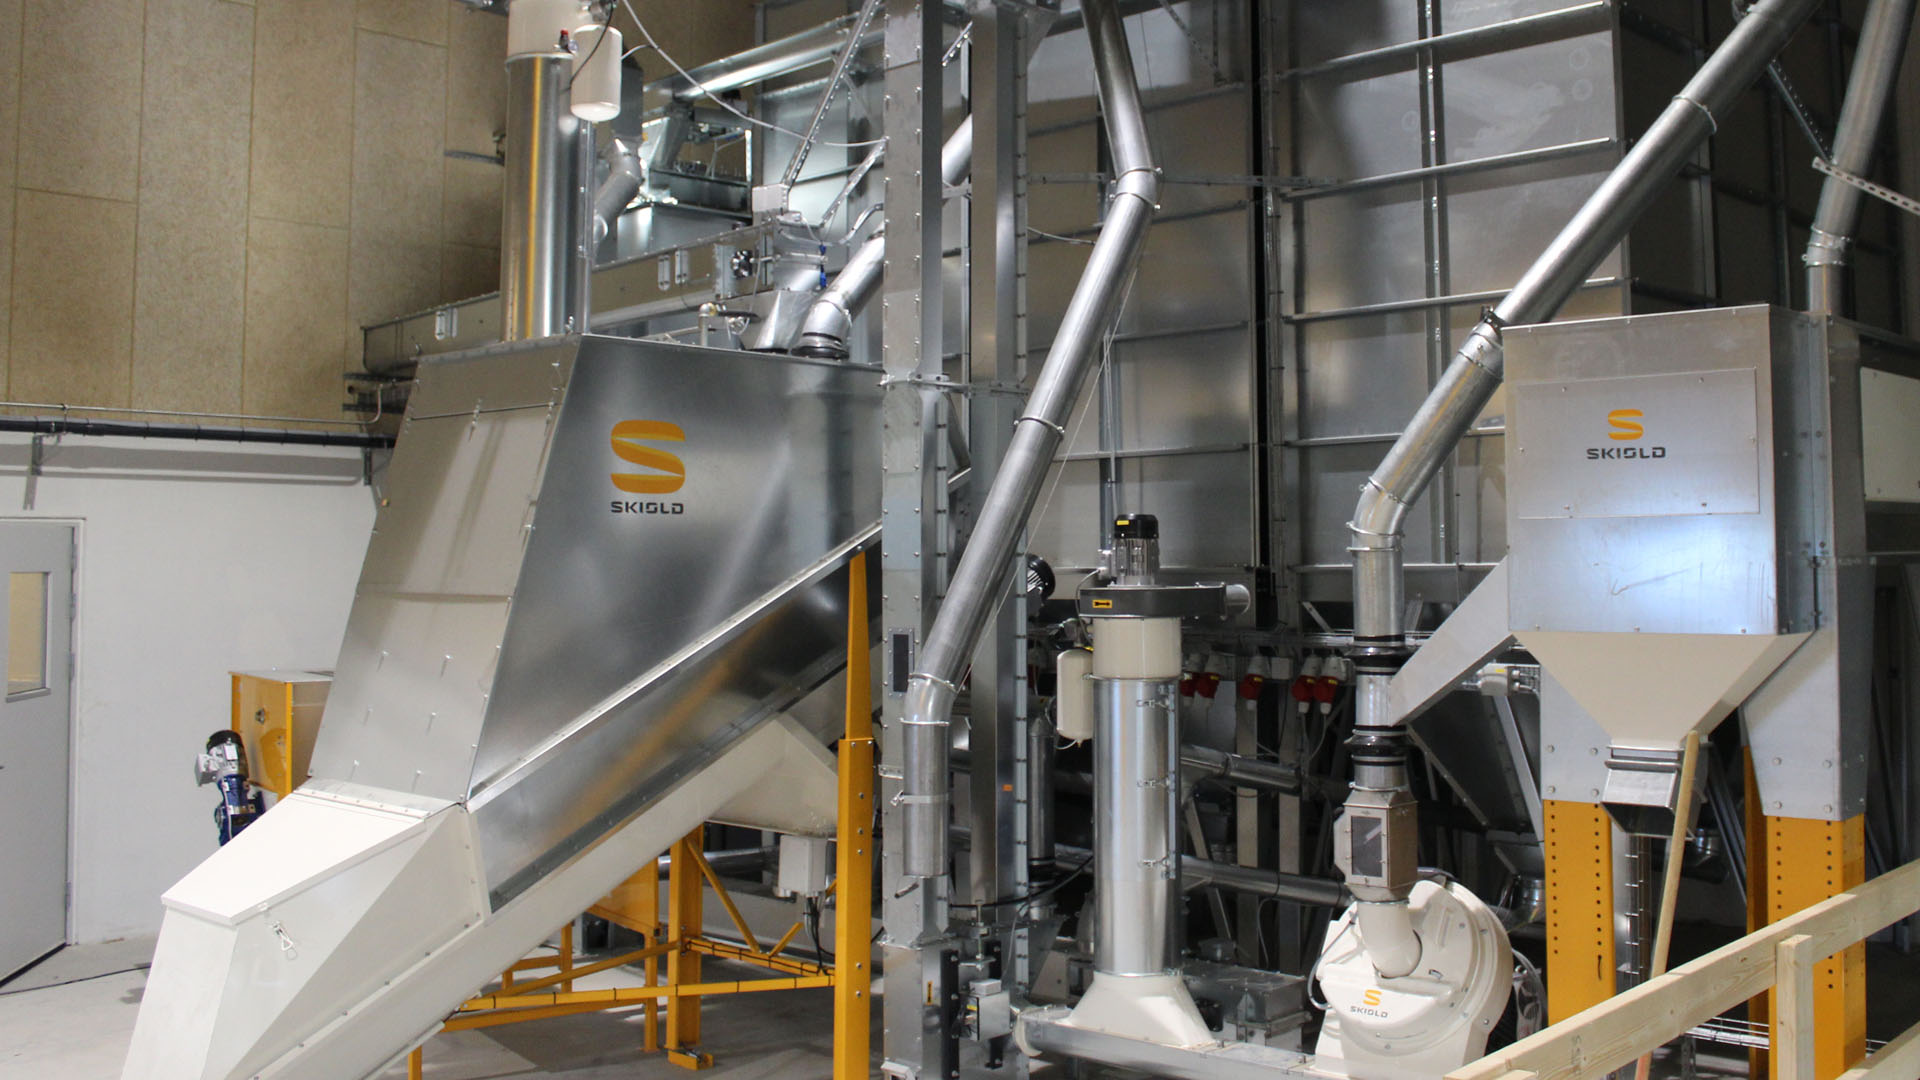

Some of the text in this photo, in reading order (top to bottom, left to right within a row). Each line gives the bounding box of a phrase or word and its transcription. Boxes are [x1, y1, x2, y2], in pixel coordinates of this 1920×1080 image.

[1586, 447, 1666, 459] SKIOLD
[610, 501, 684, 514] SKIOLD
[1350, 1005, 1388, 1018] SKIOLD
